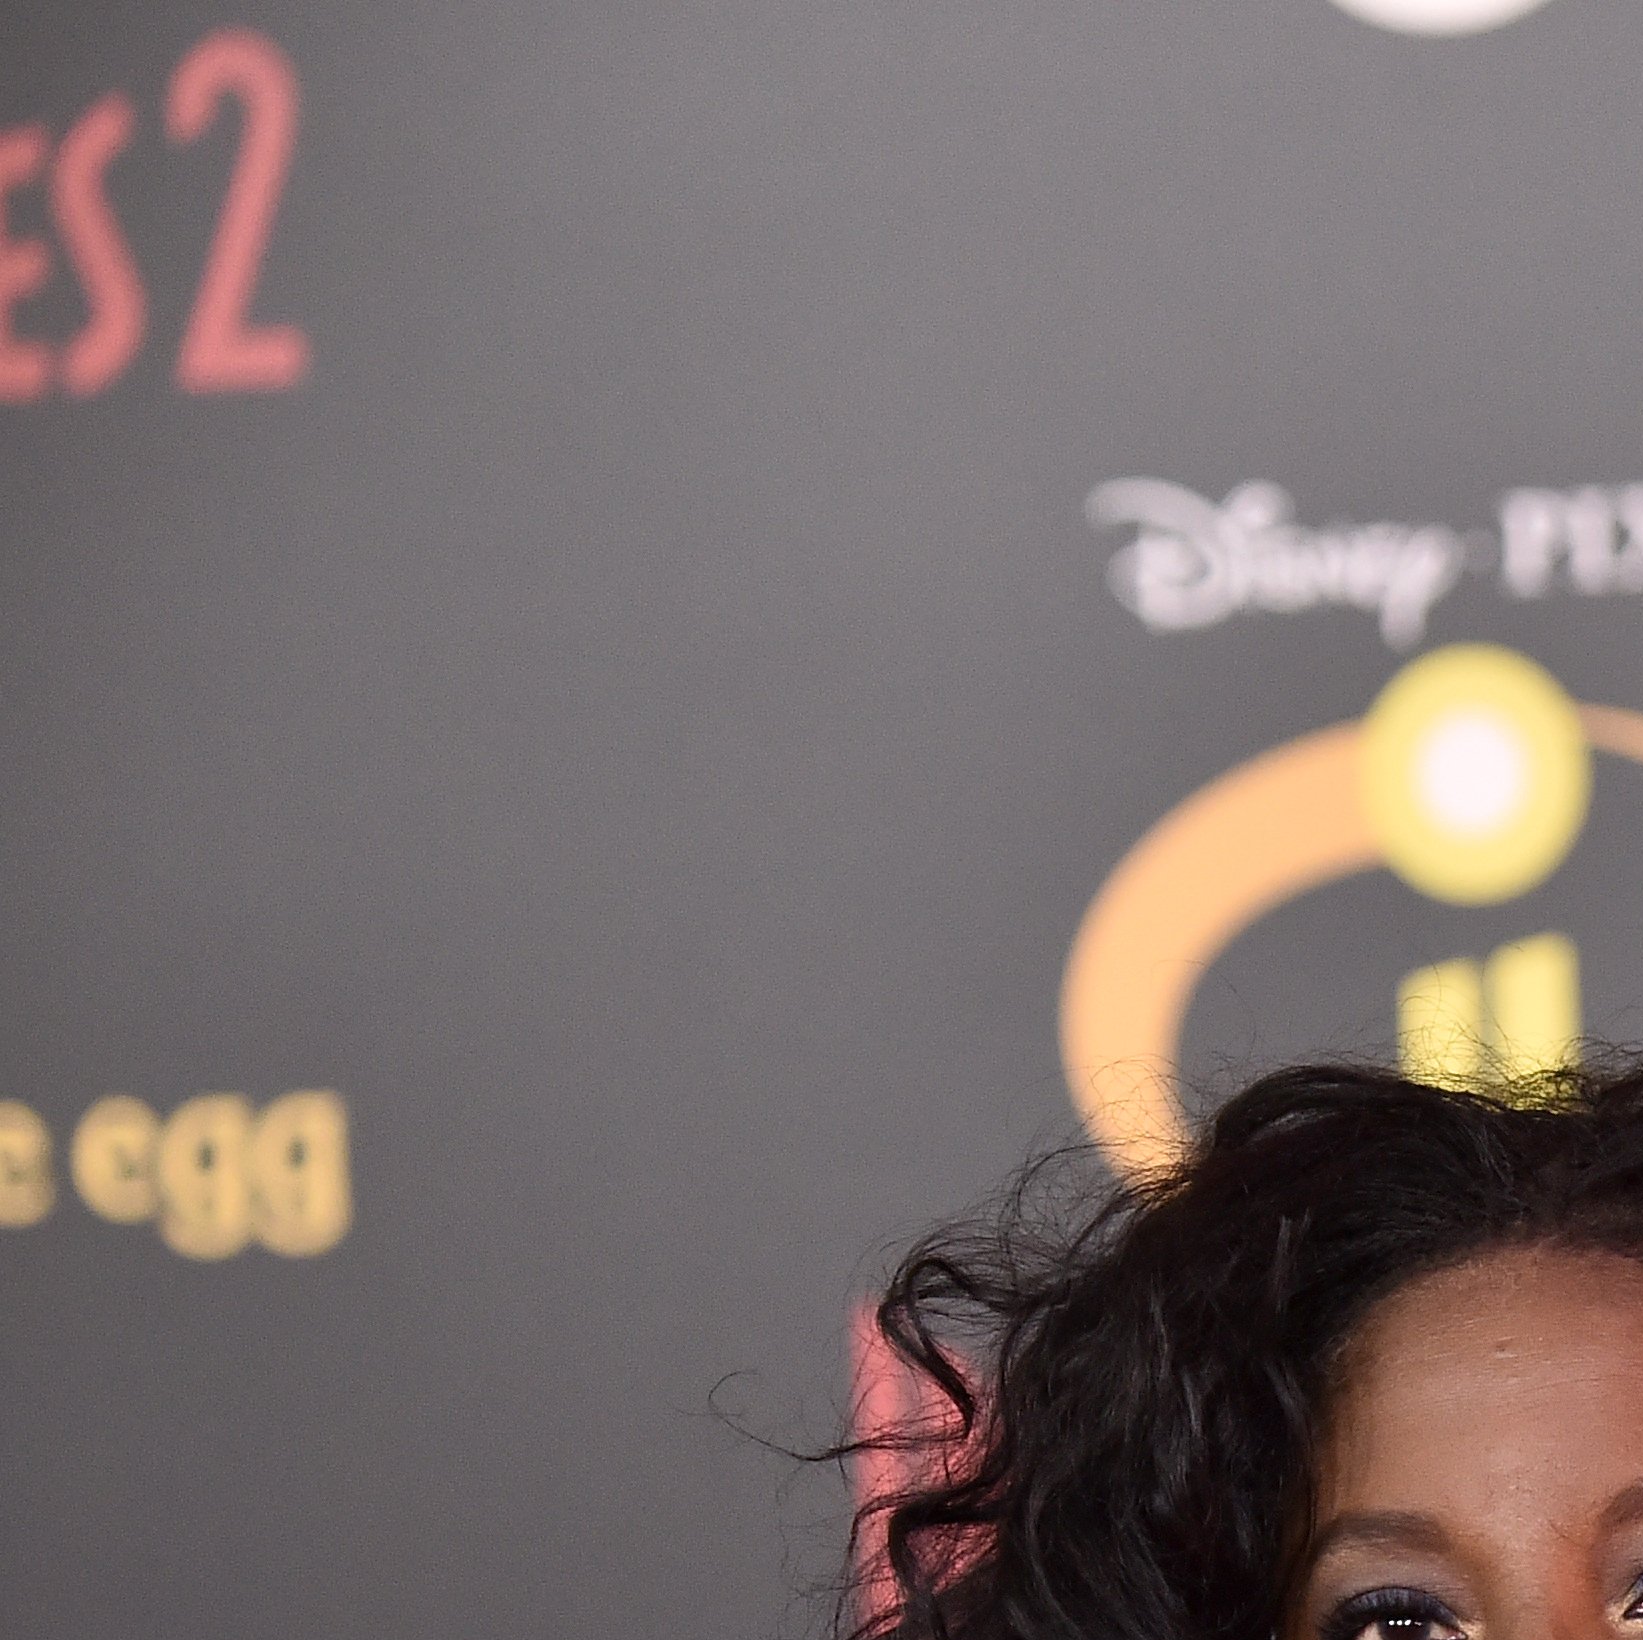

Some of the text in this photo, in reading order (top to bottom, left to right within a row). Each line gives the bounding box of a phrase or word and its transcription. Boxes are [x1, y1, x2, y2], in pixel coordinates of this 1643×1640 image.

[166, 28, 308, 388] 2
[1087, 477, 1462, 648] Disney
[72, 1092, 353, 1260] egg
